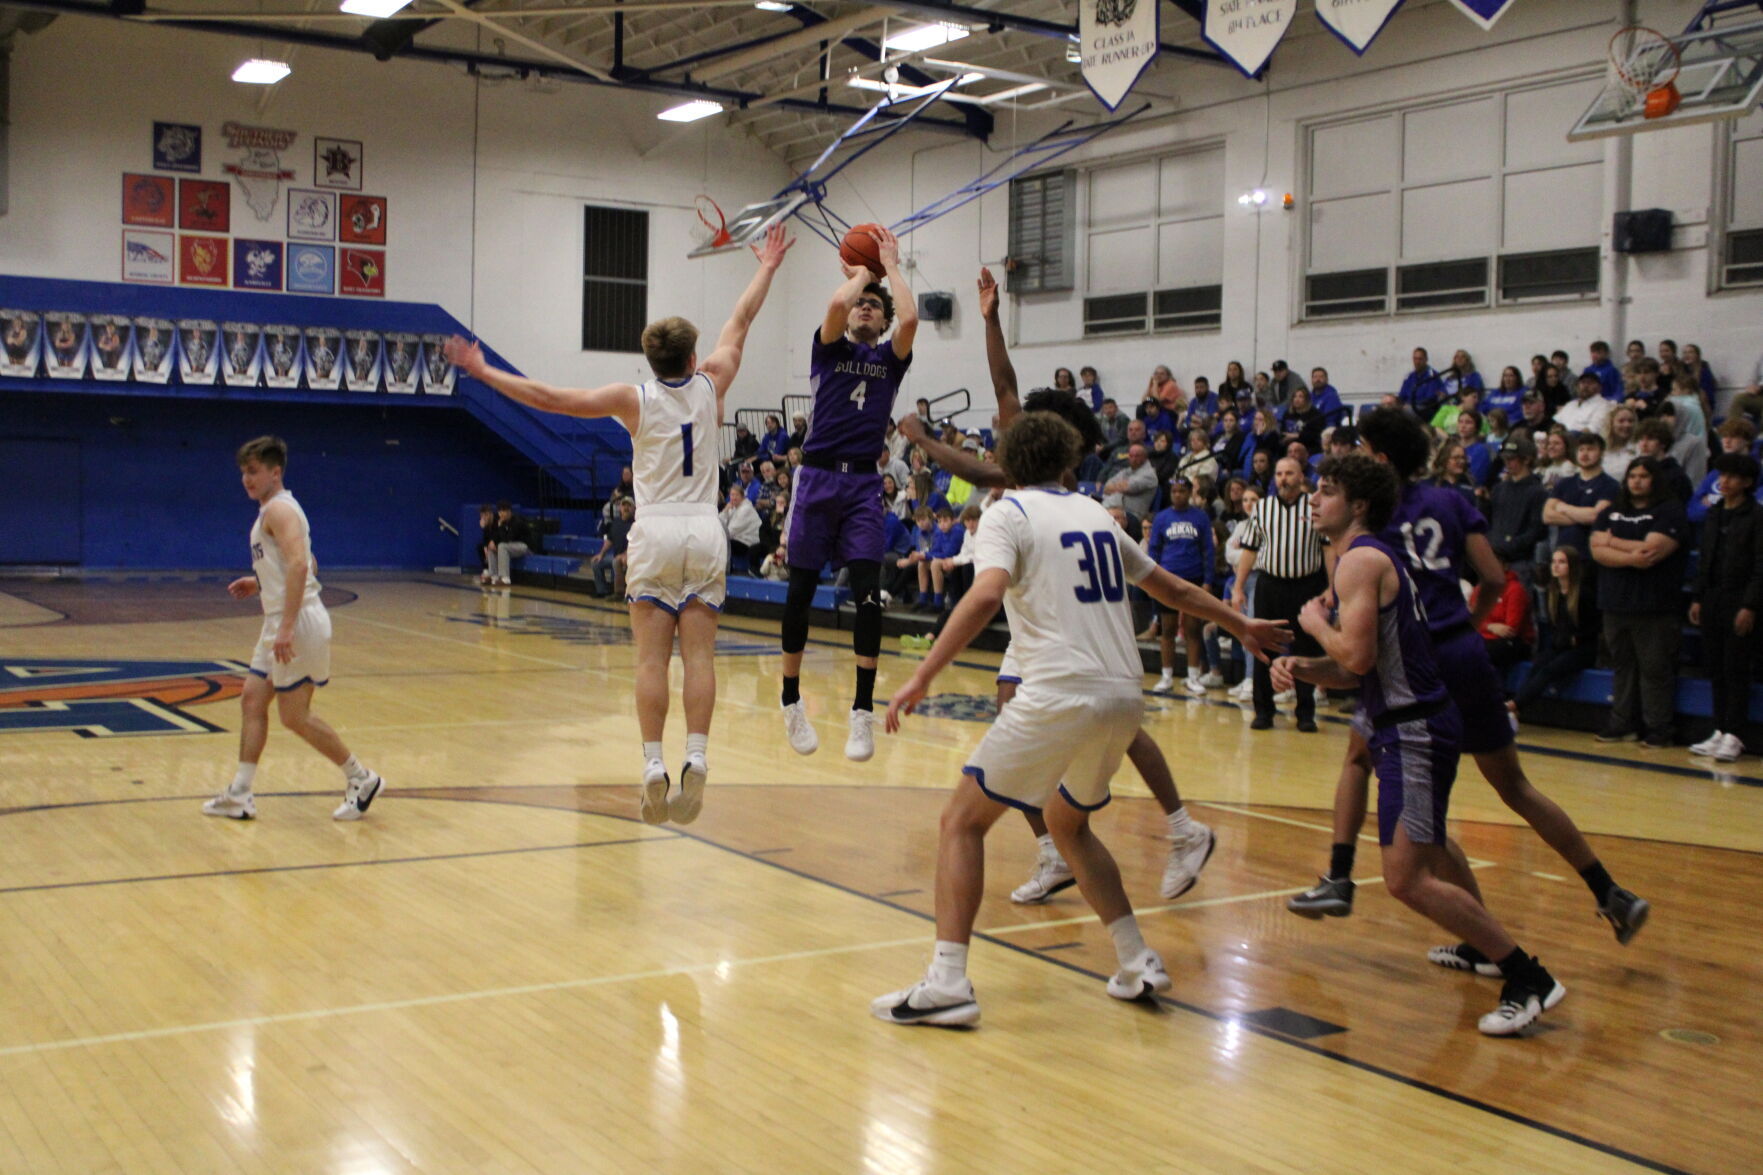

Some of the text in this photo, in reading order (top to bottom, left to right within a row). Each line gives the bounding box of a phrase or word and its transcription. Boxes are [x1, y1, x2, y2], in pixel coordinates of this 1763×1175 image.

[1094, 33, 1124, 50] CLASS
[835, 360, 888, 379] BULLDOGS
[849, 380, 867, 411] 4
[681, 422, 693, 476] 1
[841, 462, 848, 473] H
[1400, 517, 1451, 570] 12
[1060, 531, 1124, 603] 30
